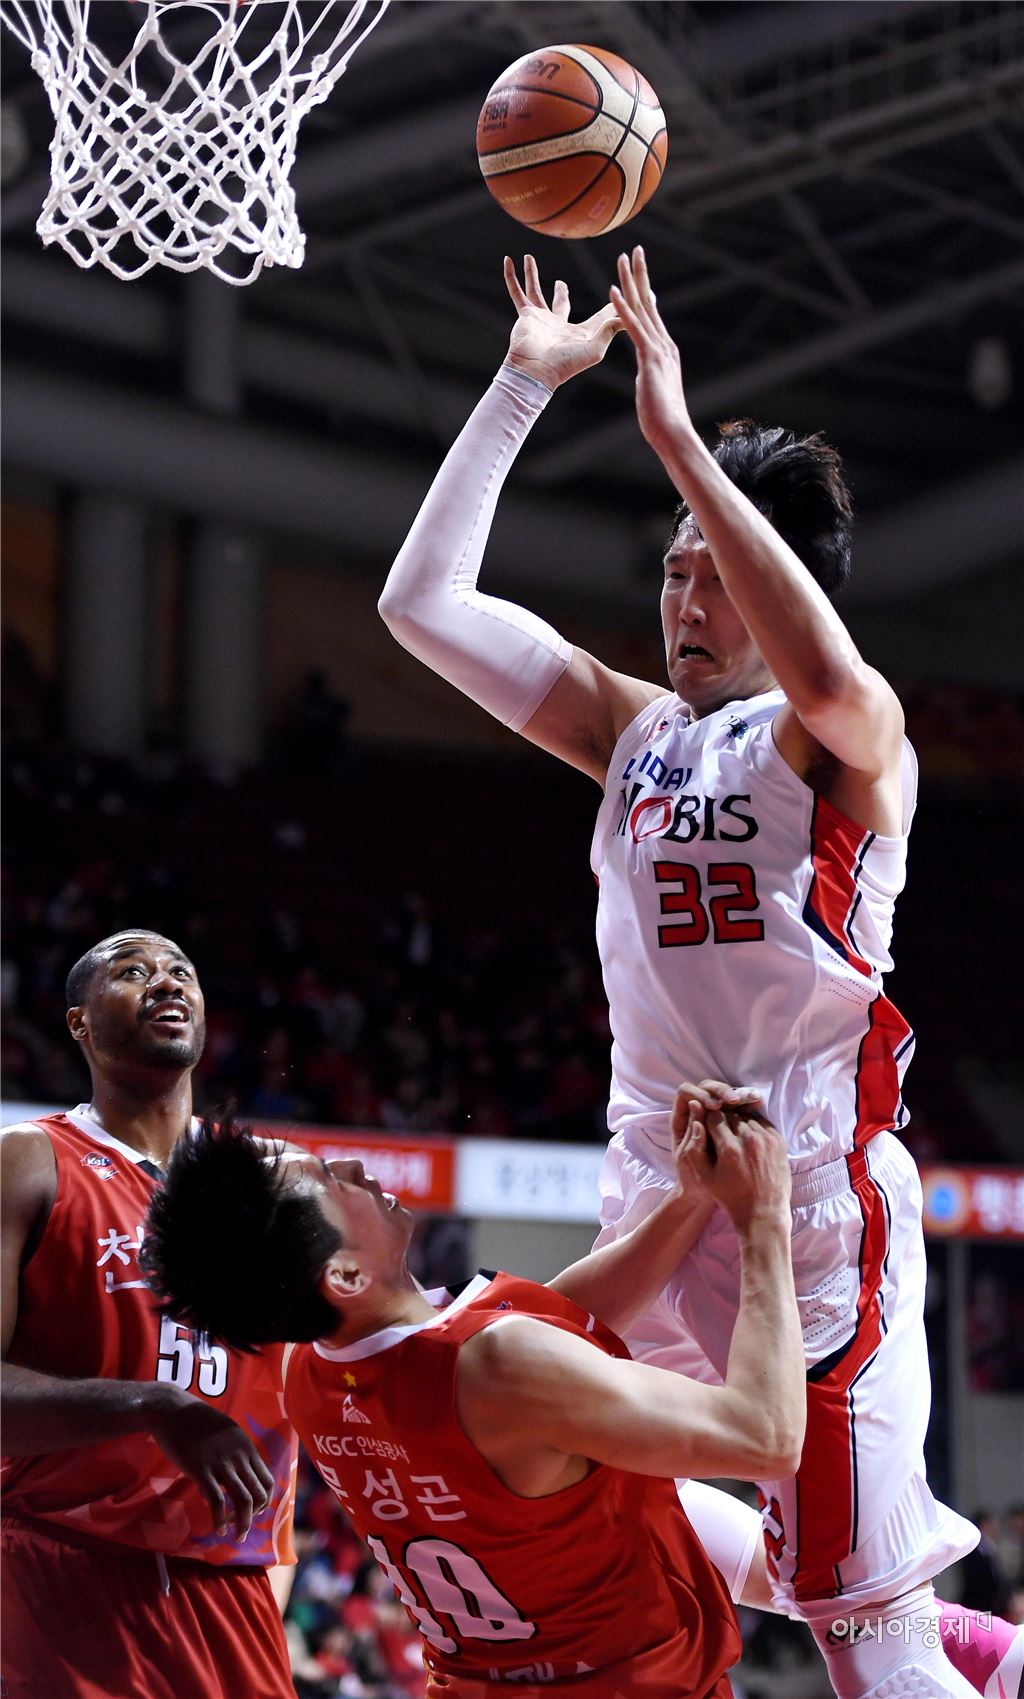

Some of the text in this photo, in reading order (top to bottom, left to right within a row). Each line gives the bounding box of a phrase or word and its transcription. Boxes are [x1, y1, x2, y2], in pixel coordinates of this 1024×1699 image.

[652, 861, 765, 948] 32
[156, 1314, 229, 1397] 55
[312, 1433, 411, 1464] KGC 인삼공사
[366, 1534, 539, 1656] 10
